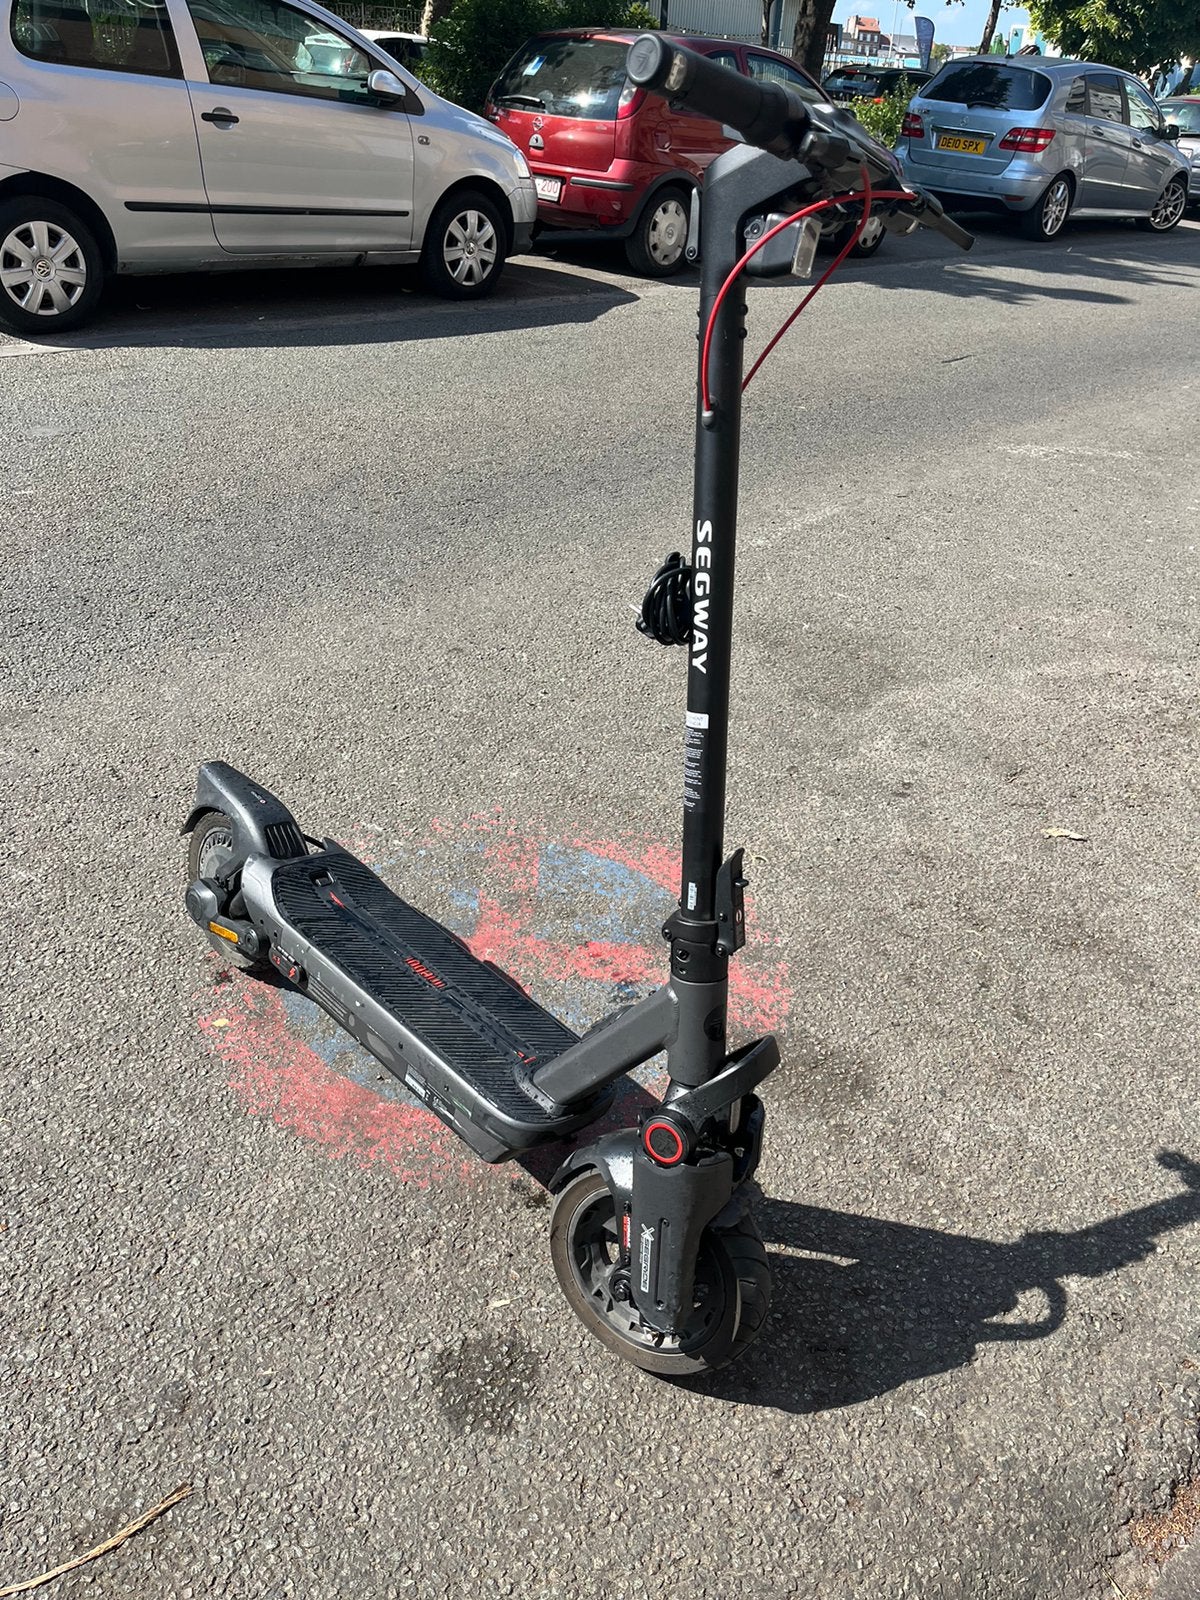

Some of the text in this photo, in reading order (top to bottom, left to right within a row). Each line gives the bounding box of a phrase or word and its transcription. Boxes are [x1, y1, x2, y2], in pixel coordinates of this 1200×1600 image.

[940, 136, 980, 152] DE10 SPX
[691, 519, 713, 675] SEGWAY
